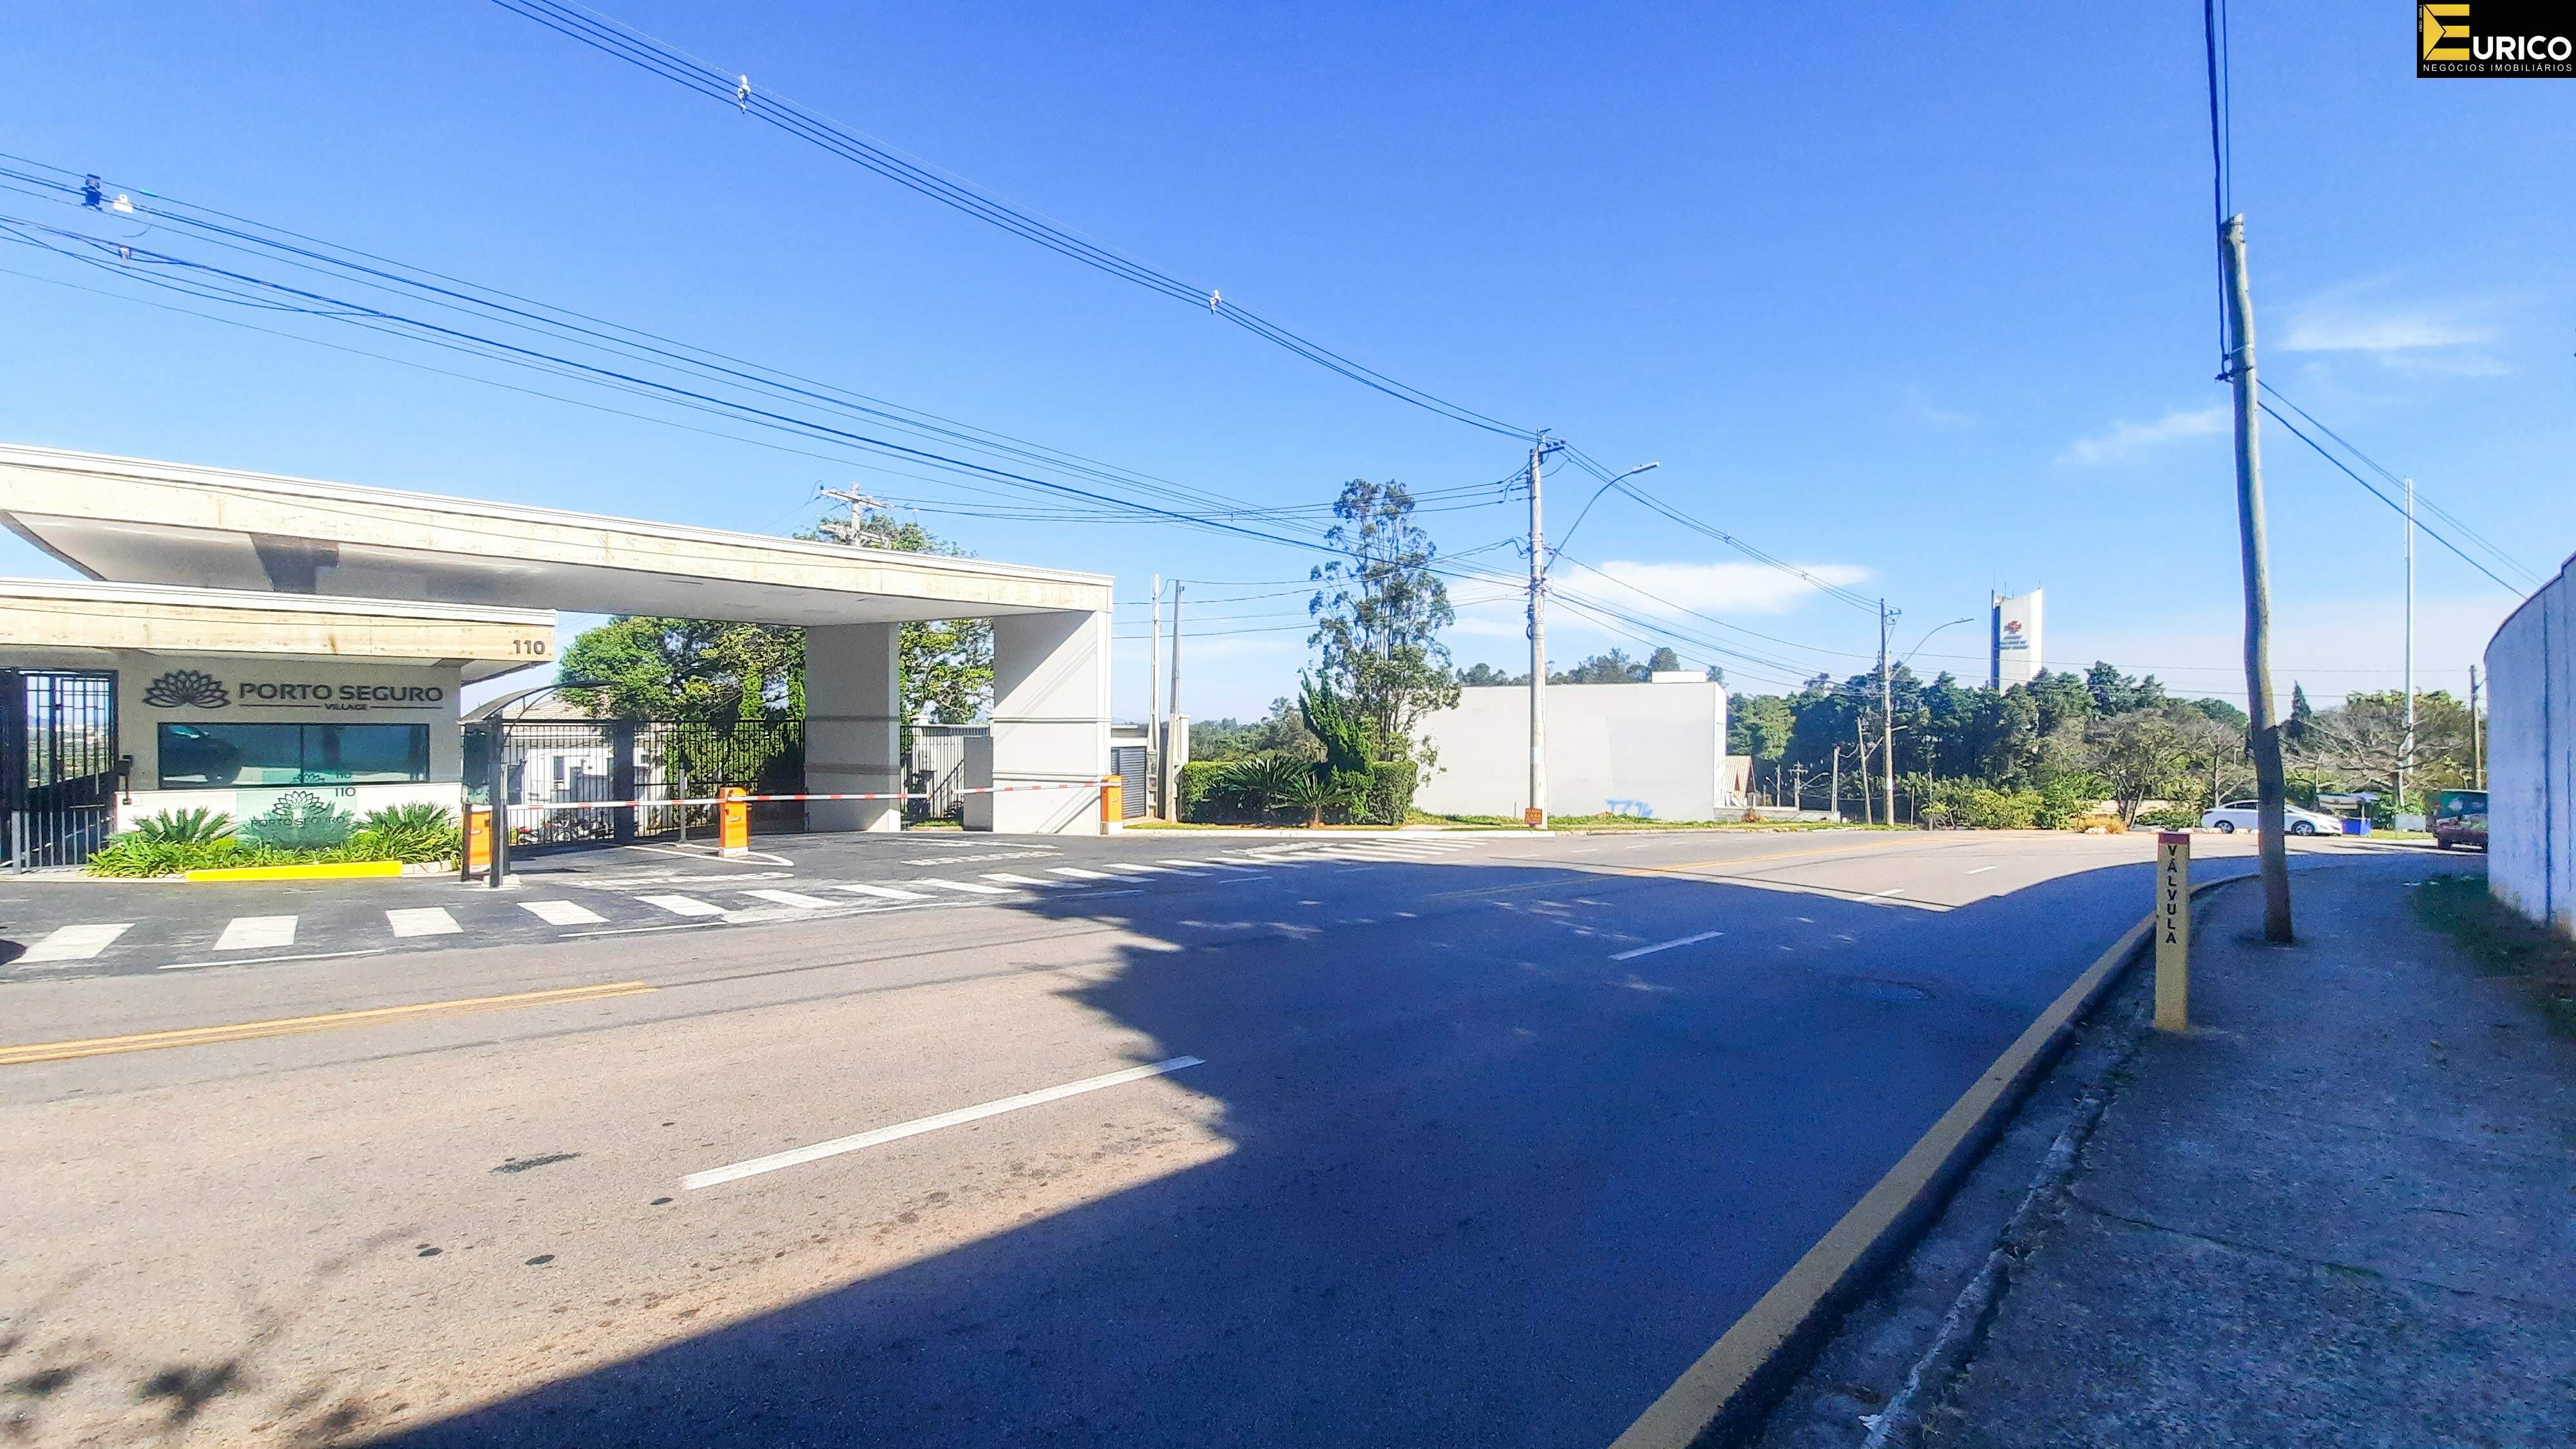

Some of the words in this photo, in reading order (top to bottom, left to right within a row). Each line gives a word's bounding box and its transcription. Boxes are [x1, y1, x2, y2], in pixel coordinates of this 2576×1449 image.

[513, 639, 546, 655] 110
[238, 683, 332, 700] PORTO
[339, 685, 444, 702] SEGURO
[336, 787, 356, 797] 110
